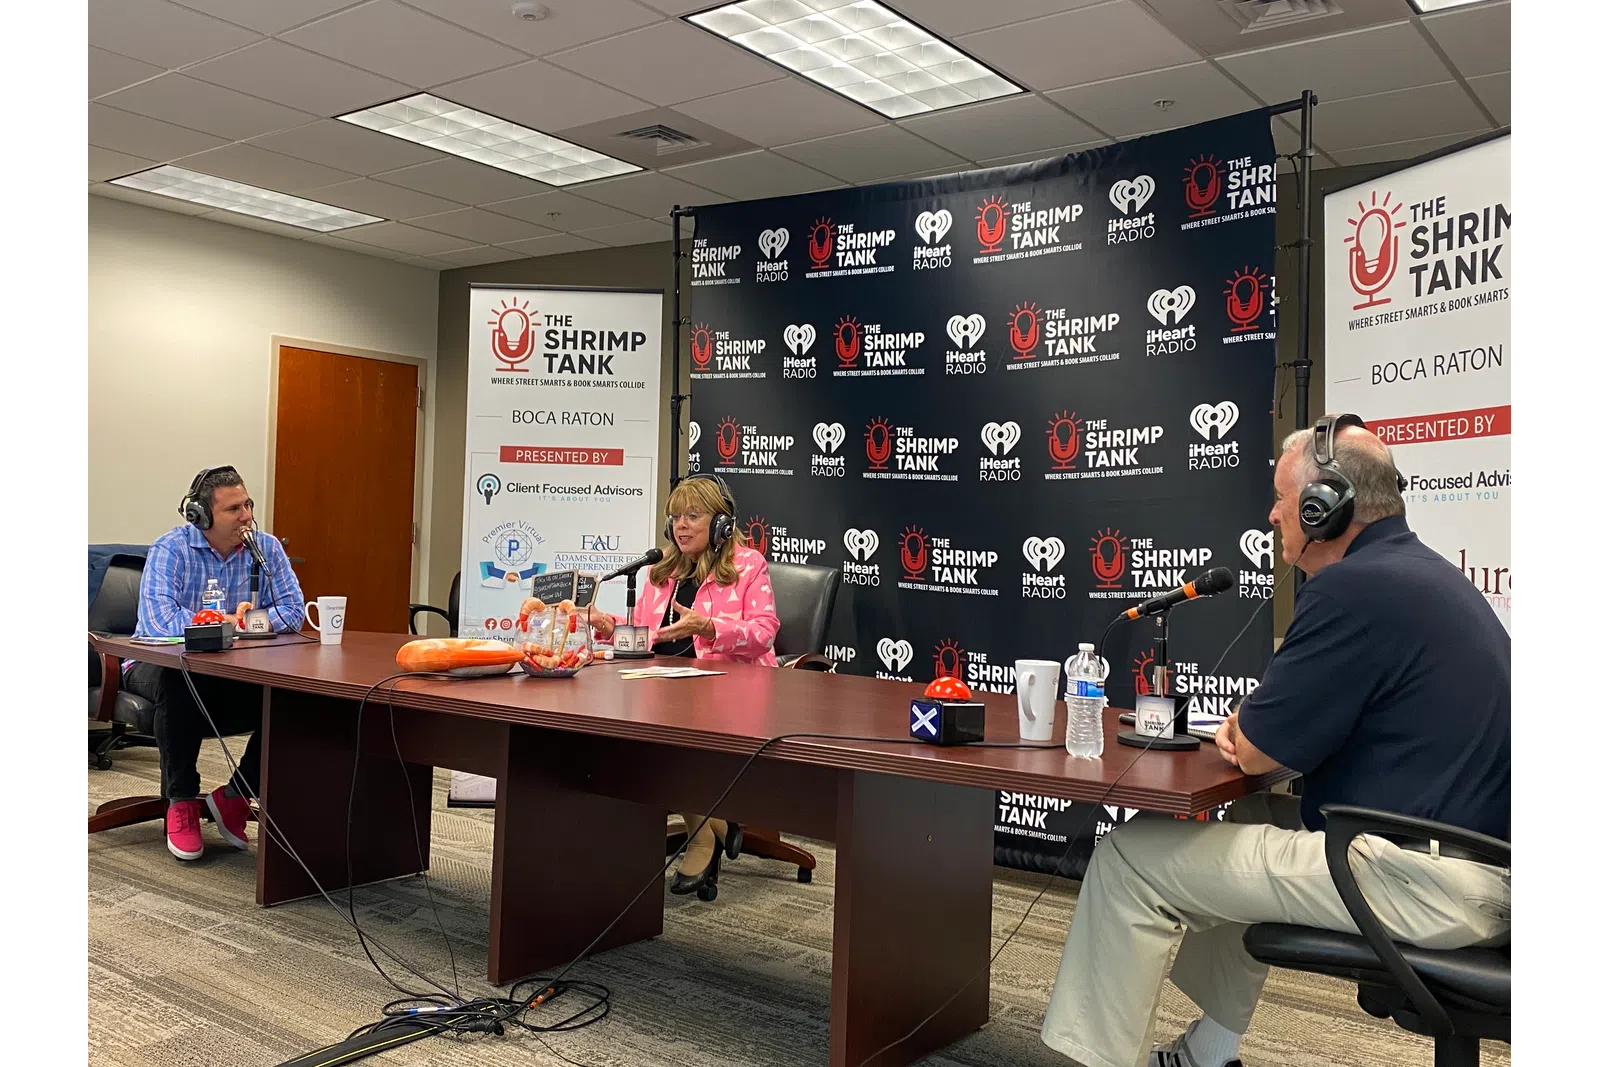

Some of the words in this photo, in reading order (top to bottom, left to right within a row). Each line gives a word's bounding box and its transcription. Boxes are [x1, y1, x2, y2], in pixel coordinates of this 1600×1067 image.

[1228, 157, 1251, 170] THE
[1012, 202, 1031, 213] THE
[1410, 196, 1445, 223] THE
[1012, 204, 1083, 231] SHRIMP
[1108, 212, 1155, 233] iHeart
[1181, 221, 1200, 230] WHERE
[1201, 217, 1220, 226] STREET
[1222, 213, 1243, 223] SMARTS
[1251, 208, 1266, 217] BOOK
[838, 224, 854, 234] THE
[1108, 226, 1155, 245] RADIO
[694, 239, 707, 247] THE
[837, 230, 895, 250] SHRIMP
[1011, 226, 1060, 249] TANK
[692, 245, 741, 262] SHRIMP
[836, 249, 876, 267] TANK
[914, 244, 951, 258] iHeart
[692, 262, 725, 278] TANK
[757, 259, 788, 272] iHeart
[913, 257, 951, 270] RADIO
[1410, 244, 1503, 297] TANK
[757, 270, 788, 283] RADIO
[1045, 309, 1065, 319] THE
[1349, 316, 1373, 331] WHERE
[1375, 310, 1403, 326] STREET
[1405, 303, 1438, 320] SMARTS
[1440, 302, 1446, 313] &
[1449, 296, 1472, 311] BOOK
[1474, 288, 1509, 306] SMARTS
[544, 315, 573, 326] THE
[1045, 313, 1120, 337] SHRIMP
[716, 332, 729, 340] THE
[864, 324, 881, 333] THE
[1146, 325, 1195, 344] iHeart
[544, 330, 646, 351] SHRIMP
[715, 340, 766, 355] SHRIMP
[864, 332, 925, 350] SHRIMP
[1045, 335, 1096, 356] TANK
[1147, 338, 1196, 356] RADIO
[716, 356, 750, 370] TANK
[783, 357, 816, 368] iHeart
[864, 351, 906, 367] TANK
[946, 350, 986, 363] iHeart
[544, 354, 614, 375] TANK
[946, 363, 986, 375] RADIO
[1372, 357, 1427, 385] BOCA
[1434, 344, 1502, 377] RATON
[783, 368, 816, 378] RADIO
[491, 377, 514, 385] WHERE
[515, 378, 538, 386] STREET
[540, 379, 565, 387] SMARTS
[620, 381, 645, 389] COLLIDE
[512, 410, 556, 425] BOCA
[562, 412, 614, 426] RATON
[1086, 420, 1107, 430] THE
[742, 426, 757, 434] THE
[896, 427, 913, 436] THE
[1377, 418, 1469, 442] PRESENTED
[1474, 414, 1495, 433] BY
[742, 435, 794, 450] SHRIMP
[1086, 426, 1164, 449] SHRIMP
[896, 438, 958, 454] SHRIMP
[1189, 441, 1238, 457] iHeart
[516, 451, 588, 463] PRESENTED
[592, 453, 608, 463] BY
[742, 451, 777, 466] TANK
[812, 454, 845, 466] iHeart
[896, 455, 939, 471] TANK
[980, 457, 1020, 469] iHeart
[1085, 447, 1139, 468] TANK
[1189, 455, 1239, 470] RADIO
[812, 466, 845, 477] RADIO
[980, 470, 1021, 481] RADIO
[507, 482, 539, 493] Client
[543, 484, 591, 495] Focused
[594, 485, 643, 496] Advisors
[1410, 472, 1472, 491] Focused
[1434, 493, 1470, 502] ABOUT
[1476, 492, 1499, 500] YOU
[482, 521, 515, 544] Premier
[519, 520, 547, 545] Virtual
[772, 527, 787, 536] THE
[581, 535, 620, 551] FAU
[772, 537, 826, 554] SHRIMP
[932, 538, 950, 548] THE
[1131, 538, 1153, 549] THE
[555, 555, 587, 563] ADAMS
[589, 555, 624, 563] CENTER
[932, 549, 998, 568] SHRIMP
[1131, 548, 1212, 569] SHRIMP
[844, 561, 879, 575] iHeart
[932, 566, 978, 585] TANK
[844, 574, 880, 586] RADIO
[1022, 573, 1065, 586] iHeart
[1131, 569, 1187, 588] TANK
[1022, 587, 1066, 599] RADIO
[968, 652, 987, 663] THE
[1175, 663, 1198, 673] THE
[1175, 675, 1260, 695] SHRIMP
[1189, 696, 1233, 715] ANK
[999, 805, 1048, 829] TANK
